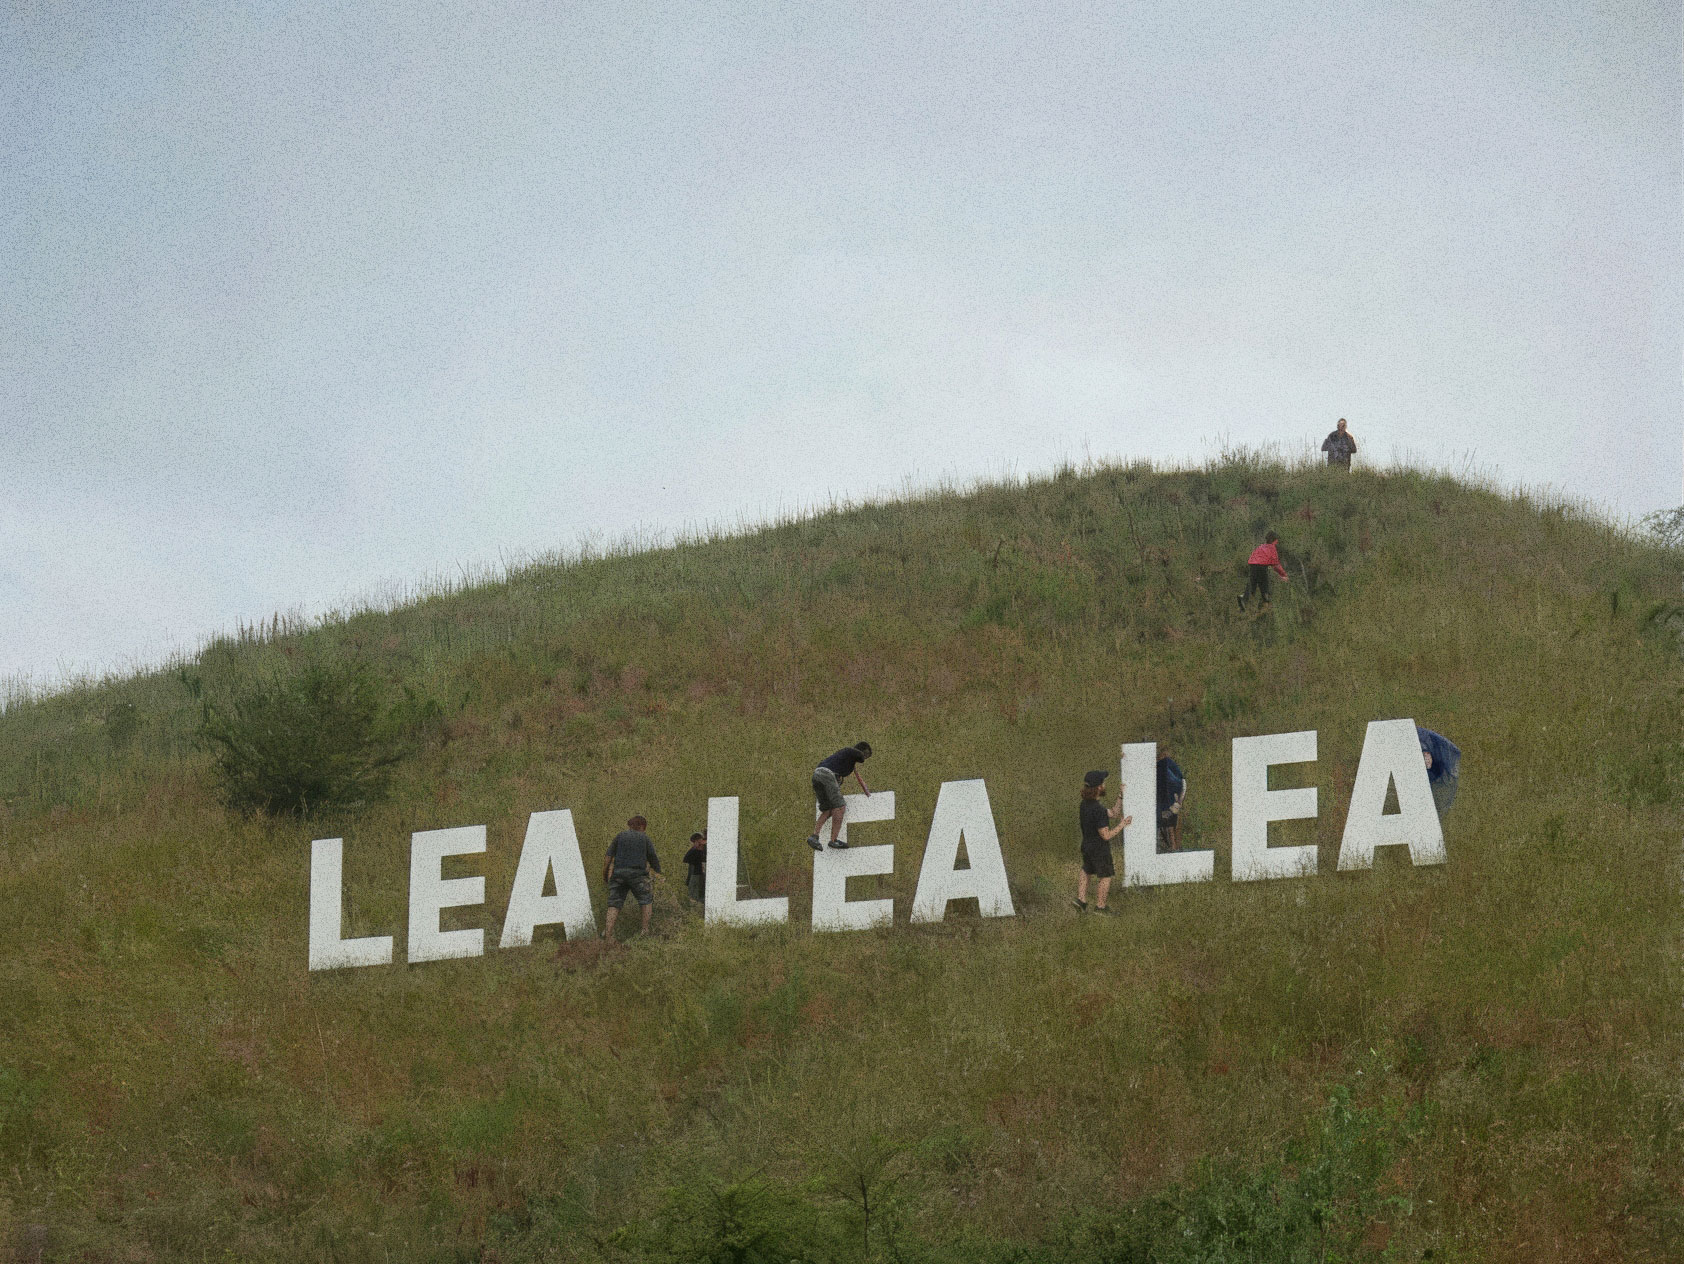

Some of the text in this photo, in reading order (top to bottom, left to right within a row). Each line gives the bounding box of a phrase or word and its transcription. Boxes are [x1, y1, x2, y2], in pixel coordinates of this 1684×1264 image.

[309, 718, 1447, 971] LEA LEA LEA
